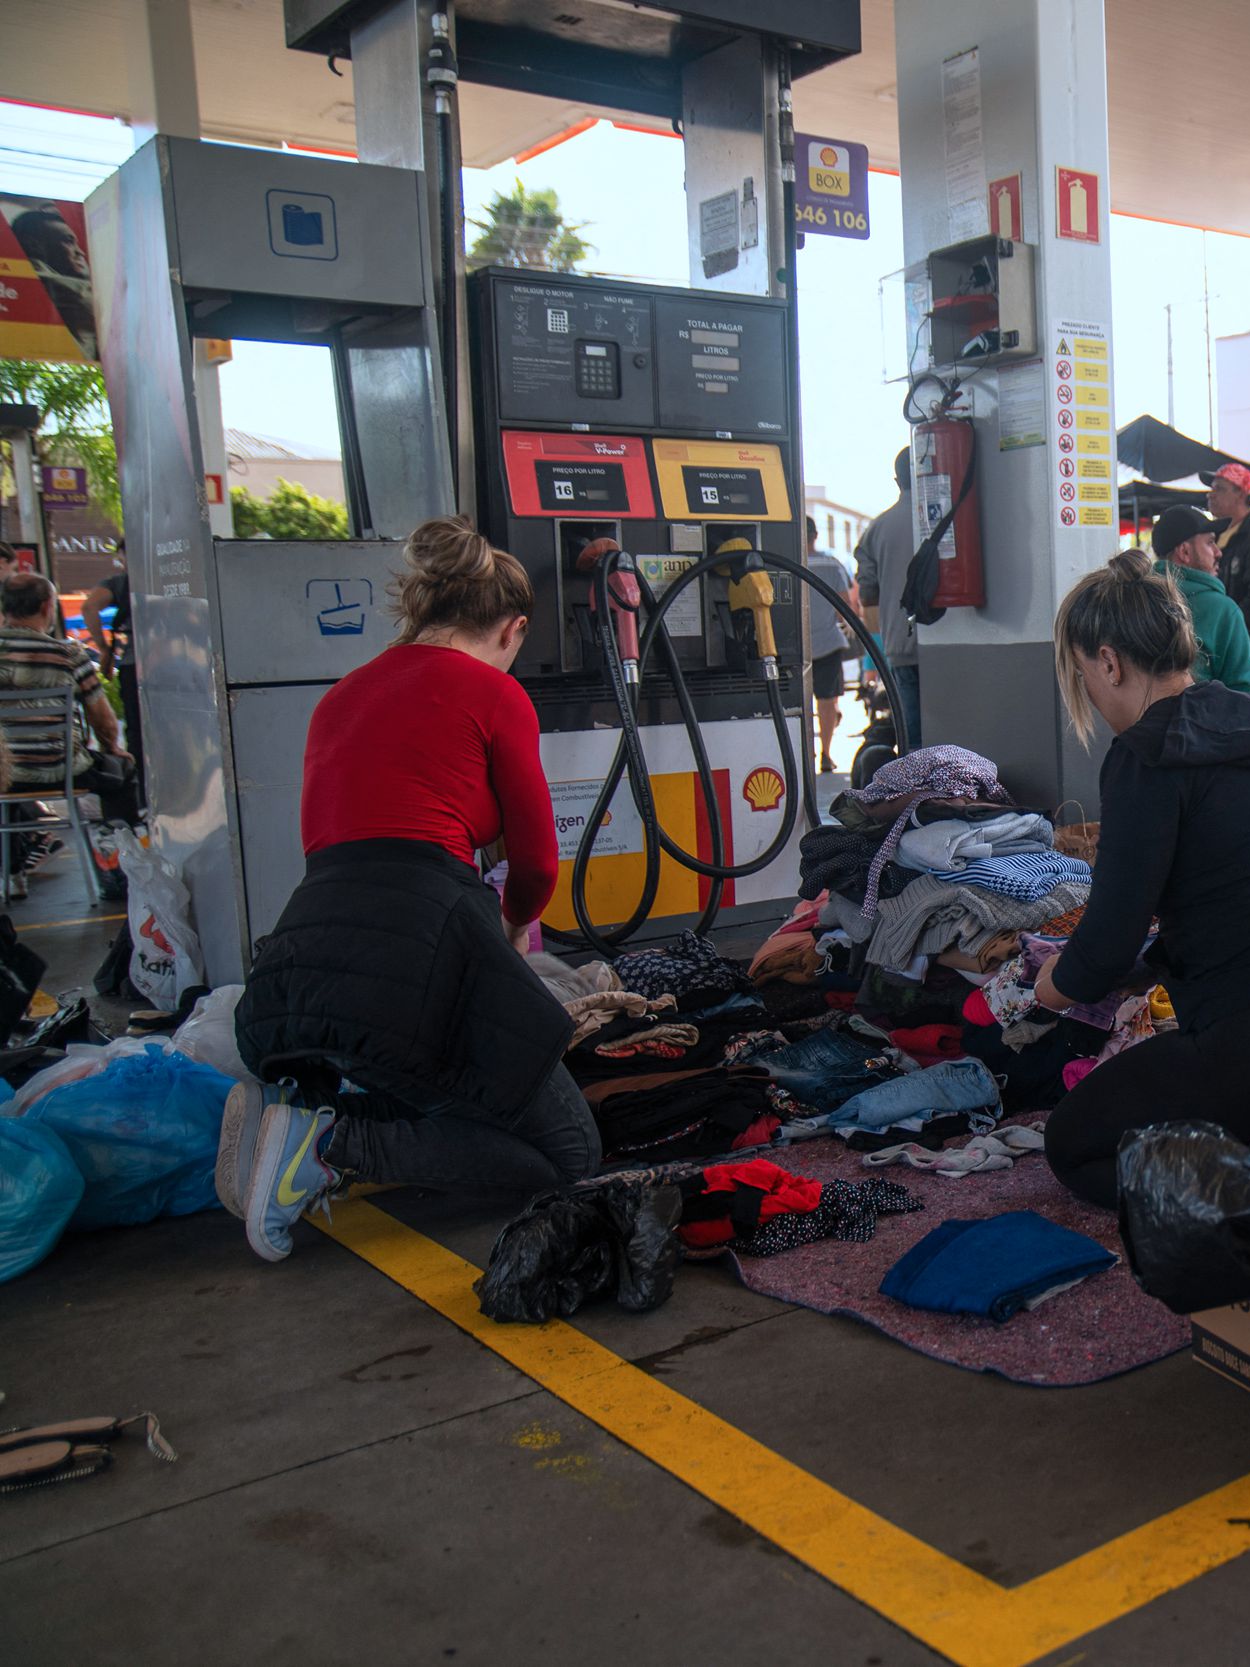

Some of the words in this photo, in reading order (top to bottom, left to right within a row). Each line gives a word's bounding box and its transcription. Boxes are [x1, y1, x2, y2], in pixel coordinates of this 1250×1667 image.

[815, 173, 843, 190] BOX
[833, 209, 867, 231] 106
[552, 290, 574, 298] MOTOR
[687, 320, 710, 330] TOTAL
[711, 321, 717, 330] A
[718, 322, 743, 332] PAGAR
[679, 330, 689, 339] R$
[703, 346, 729, 355] LITROS
[552, 467, 574, 475] PREÇO
[555, 485, 572, 496] 16
[702, 490, 718, 500] 15
